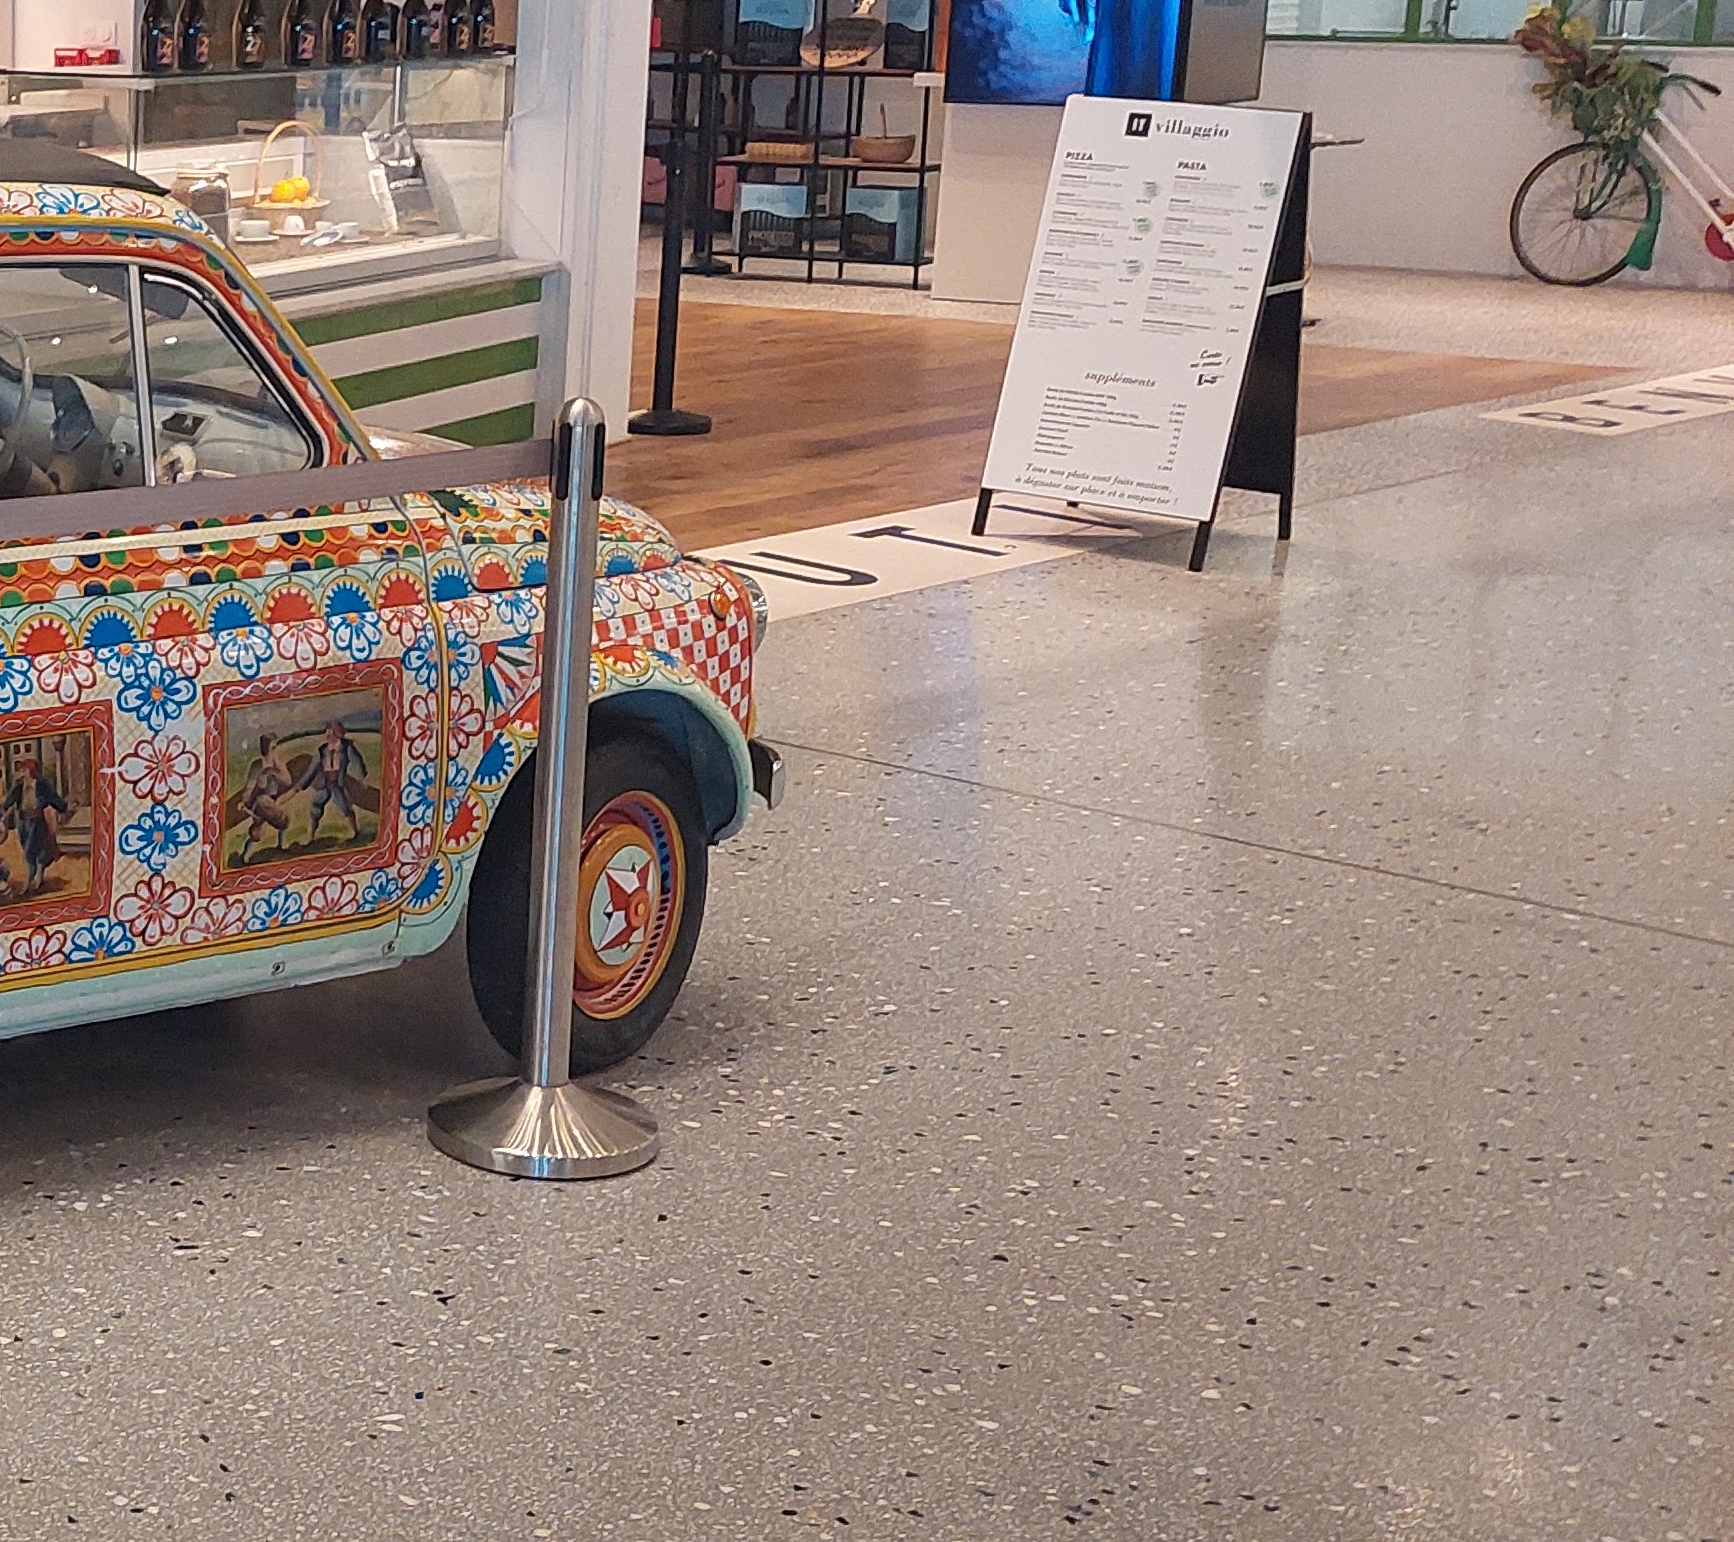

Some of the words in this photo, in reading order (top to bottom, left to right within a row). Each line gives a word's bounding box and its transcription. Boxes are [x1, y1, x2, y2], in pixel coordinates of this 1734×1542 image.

[1155, 118, 1230, 138] villaggio
[1065, 151, 1094, 161] PIZZA
[1176, 161, 1207, 171] PASTA
[1084, 371, 1157, 388] suppléments
